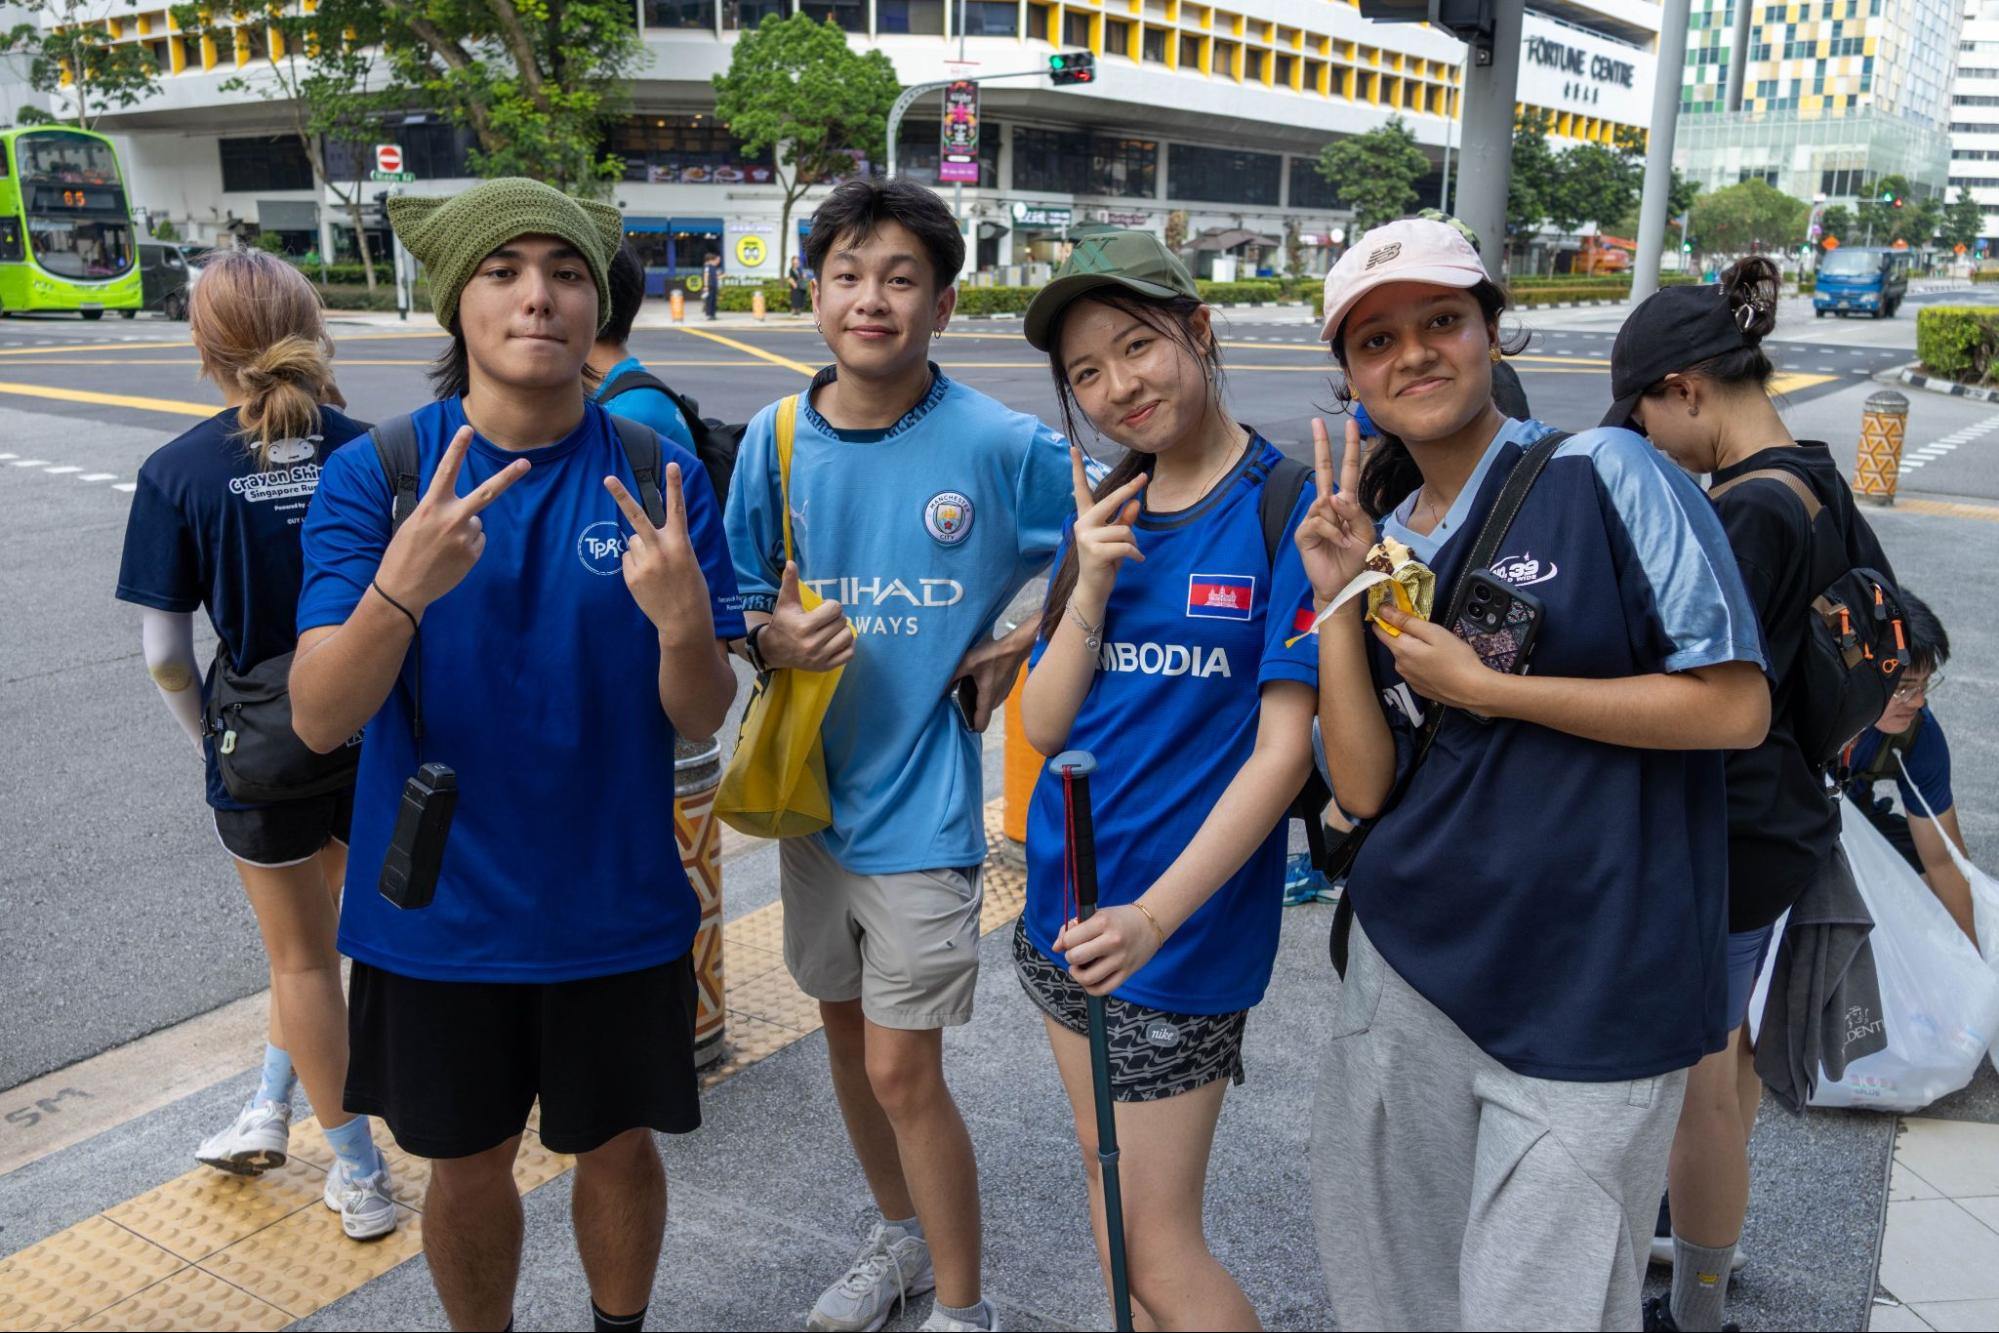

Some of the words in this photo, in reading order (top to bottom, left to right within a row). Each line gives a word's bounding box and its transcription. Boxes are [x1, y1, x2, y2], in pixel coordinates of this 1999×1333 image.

[1523, 36, 1586, 76] FORTUNE
[1591, 54, 1635, 89] CENTRE
[229, 470, 290, 494] Crayon
[249, 486, 299, 499] Singapore
[930, 494, 971, 512] MANCHESTER
[1508, 560, 1539, 578] 39
[804, 577, 964, 607] TIHAD
[846, 616, 919, 636] WAYS
[1096, 642, 1232, 679] MBODIA
[1151, 1028, 1174, 1041] nike
